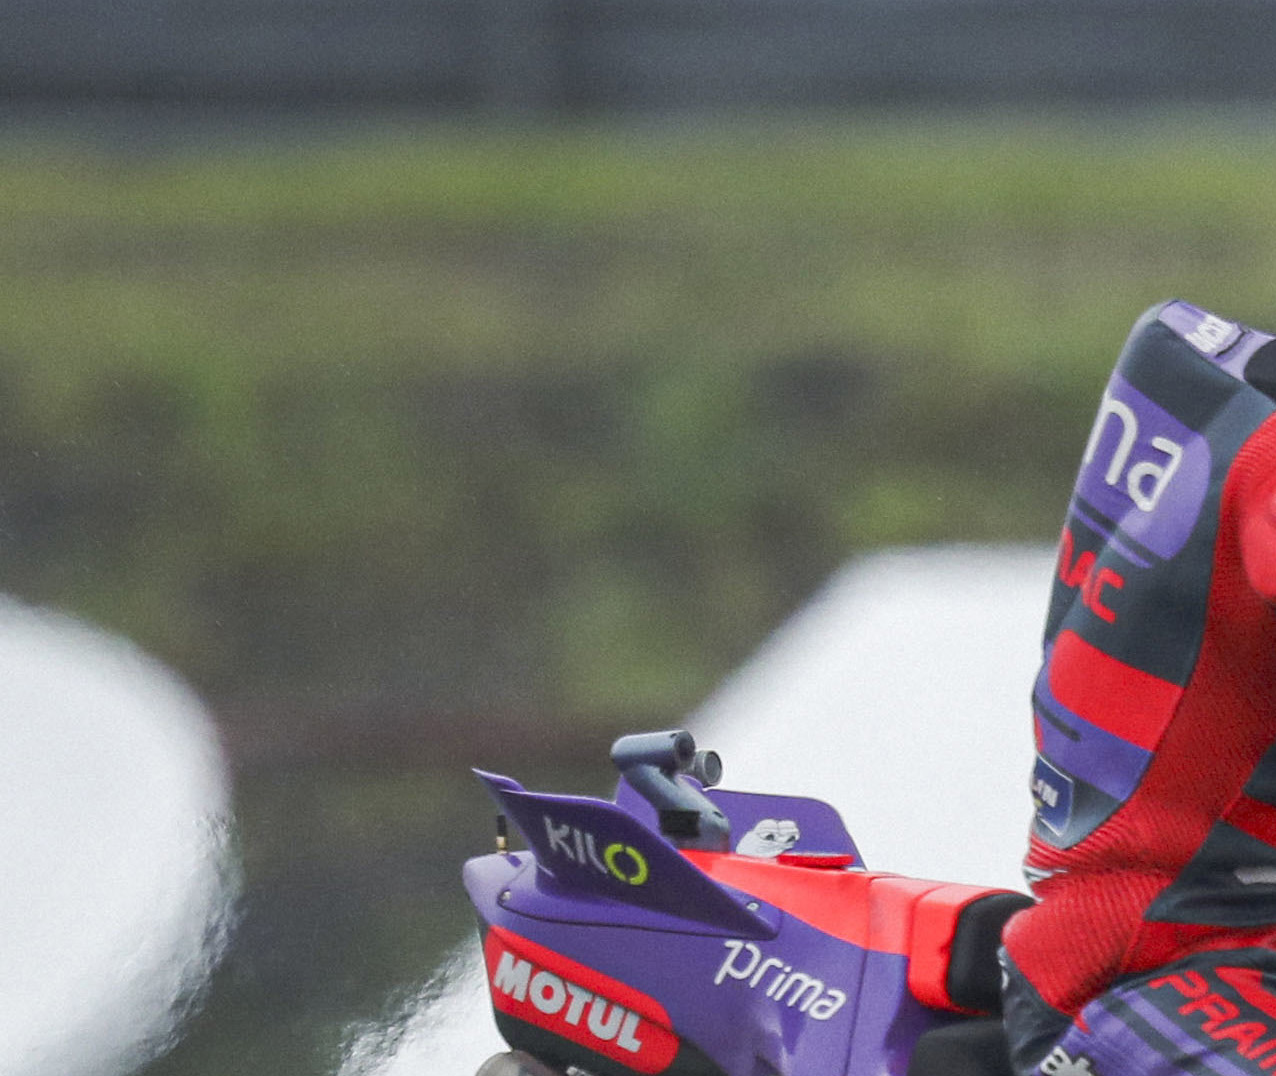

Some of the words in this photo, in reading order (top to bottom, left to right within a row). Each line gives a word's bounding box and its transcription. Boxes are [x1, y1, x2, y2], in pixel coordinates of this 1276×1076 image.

[543, 816, 650, 887] KILO
[493, 950, 643, 1052] MOTUL
[713, 940, 847, 1021] prima
